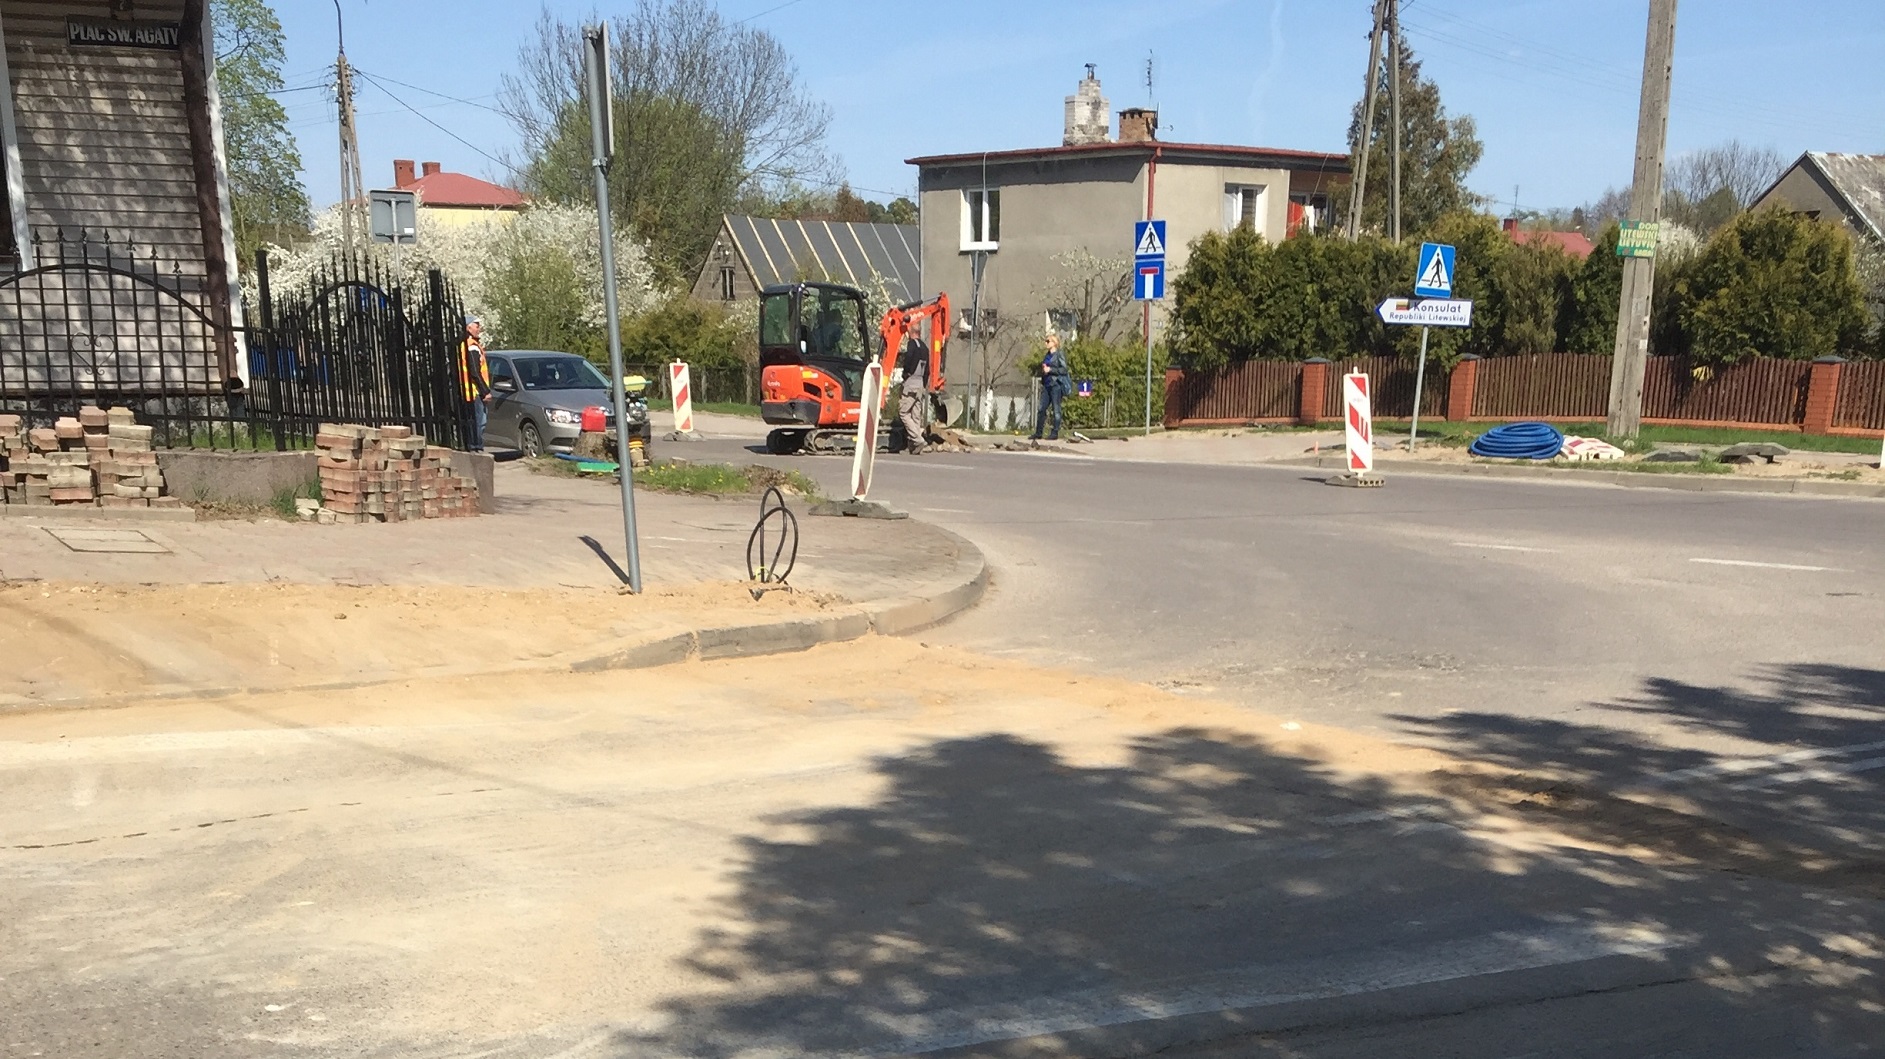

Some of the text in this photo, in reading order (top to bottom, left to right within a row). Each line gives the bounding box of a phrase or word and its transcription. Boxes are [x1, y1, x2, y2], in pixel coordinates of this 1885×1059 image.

[69, 22, 105, 41] PLAC
[135, 27, 179, 45] AGATY
[1413, 302, 1461, 313] Konsulat
[1389, 311, 1466, 323] Republiki Litewskiej
[1082, 382, 1088, 392] 1
